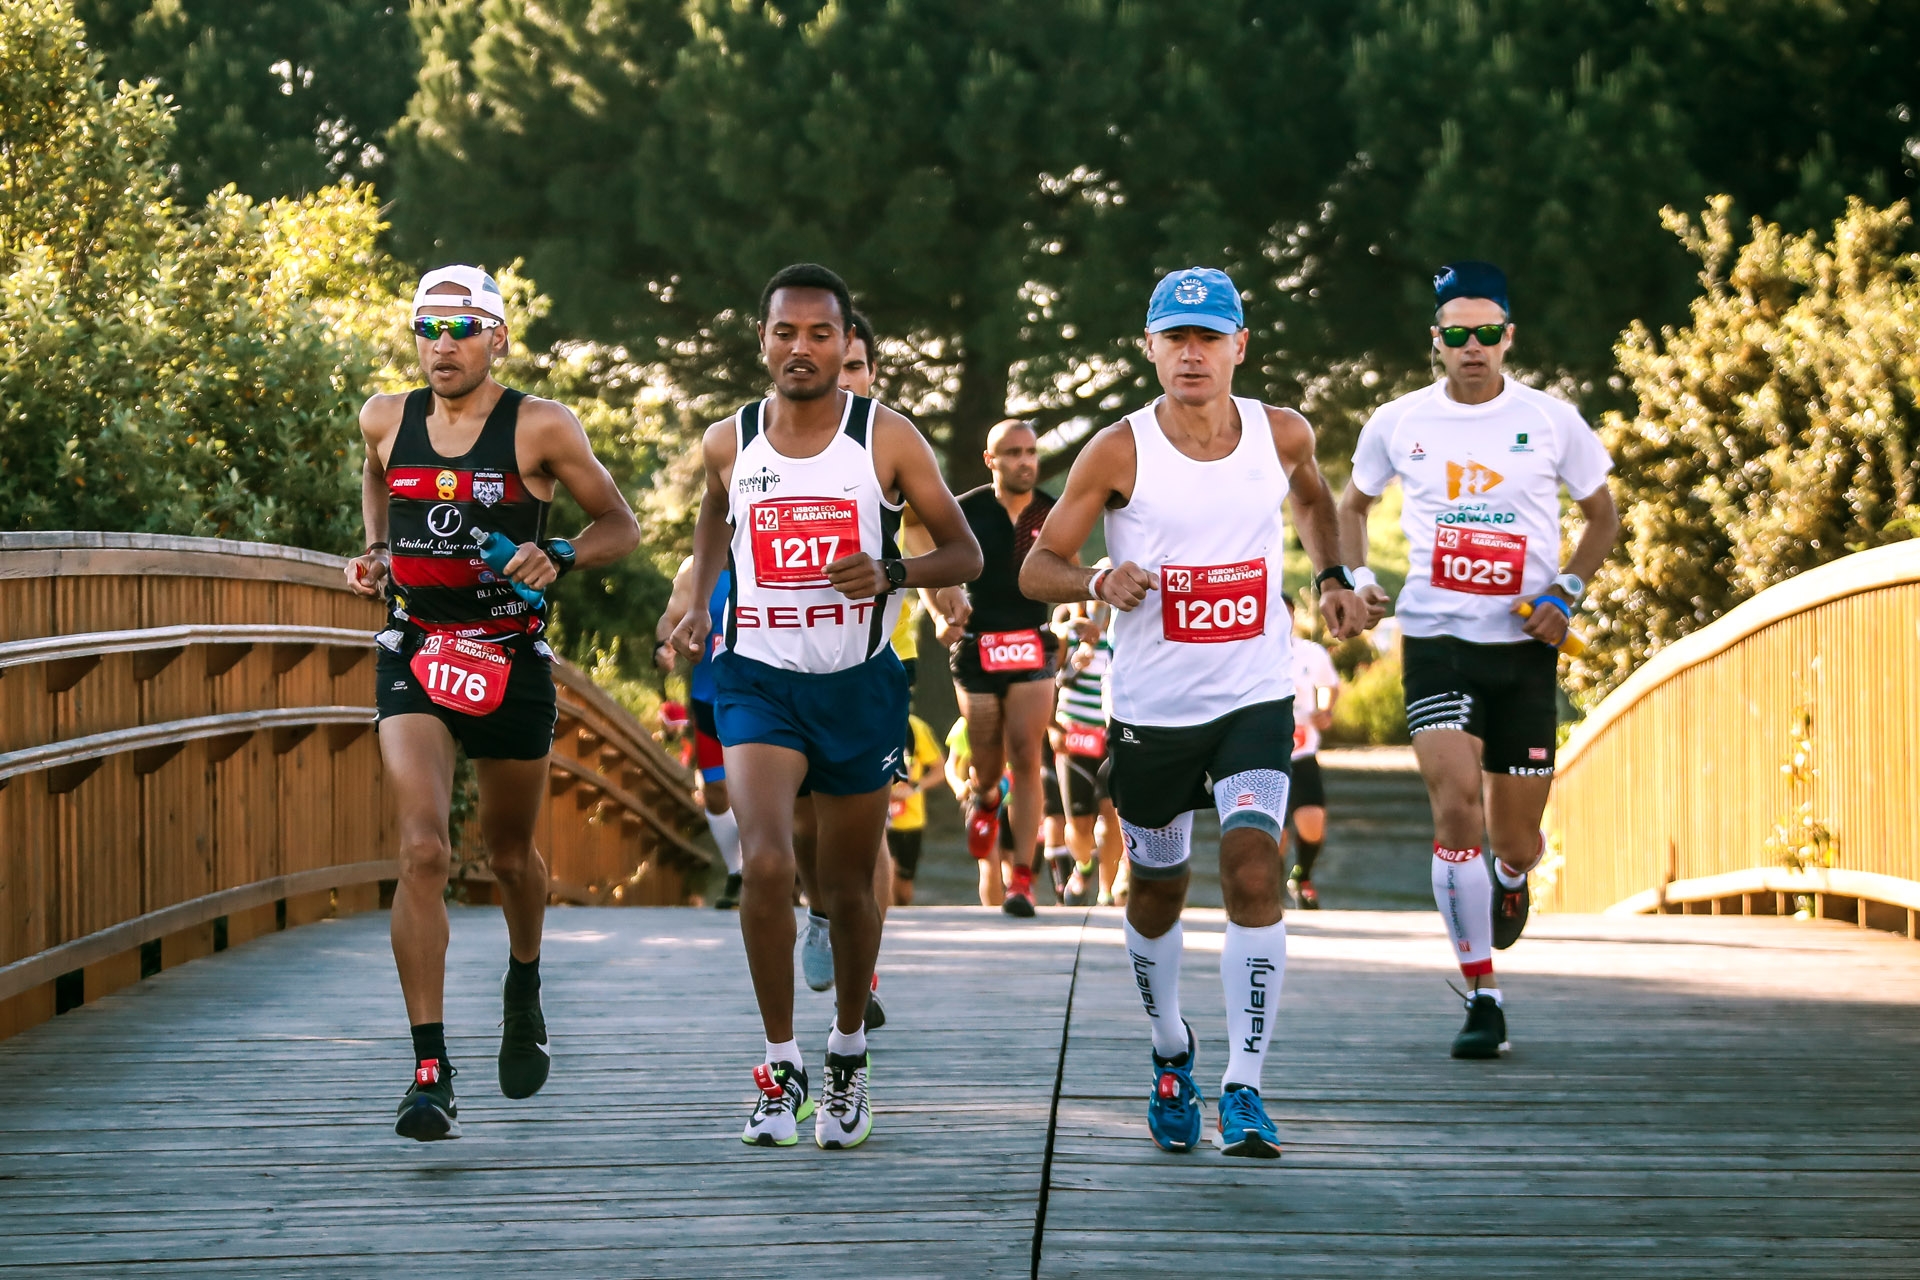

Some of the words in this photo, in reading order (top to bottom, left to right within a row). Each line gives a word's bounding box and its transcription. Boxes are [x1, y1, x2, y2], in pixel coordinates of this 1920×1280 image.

[739, 485, 761, 494] MATE
[792, 505, 820, 513] LISBON
[793, 510, 852, 521] MARATHON
[1435, 512, 1516, 524] FORWARD
[757, 509, 777, 529] 42
[1438, 530, 1457, 548] 42
[1471, 538, 1521, 550] MARATHON
[771, 535, 840, 568] 1217
[1207, 567, 1235, 576] LISBON
[1235, 564, 1250, 572] ECO
[1207, 568, 1263, 583] MARATHON
[1442, 554, 1513, 585] 1025
[1168, 572, 1189, 591] 42
[736, 602, 878, 628] SEAT
[1175, 595, 1258, 629] 1209
[455, 643, 506, 665] MARATHON
[457, 638, 483, 650] LISBON
[482, 643, 496, 654] ECO
[987, 642, 1036, 663] 1002
[427, 661, 487, 702] 1176
[1243, 957, 1275, 1053] kalenji
